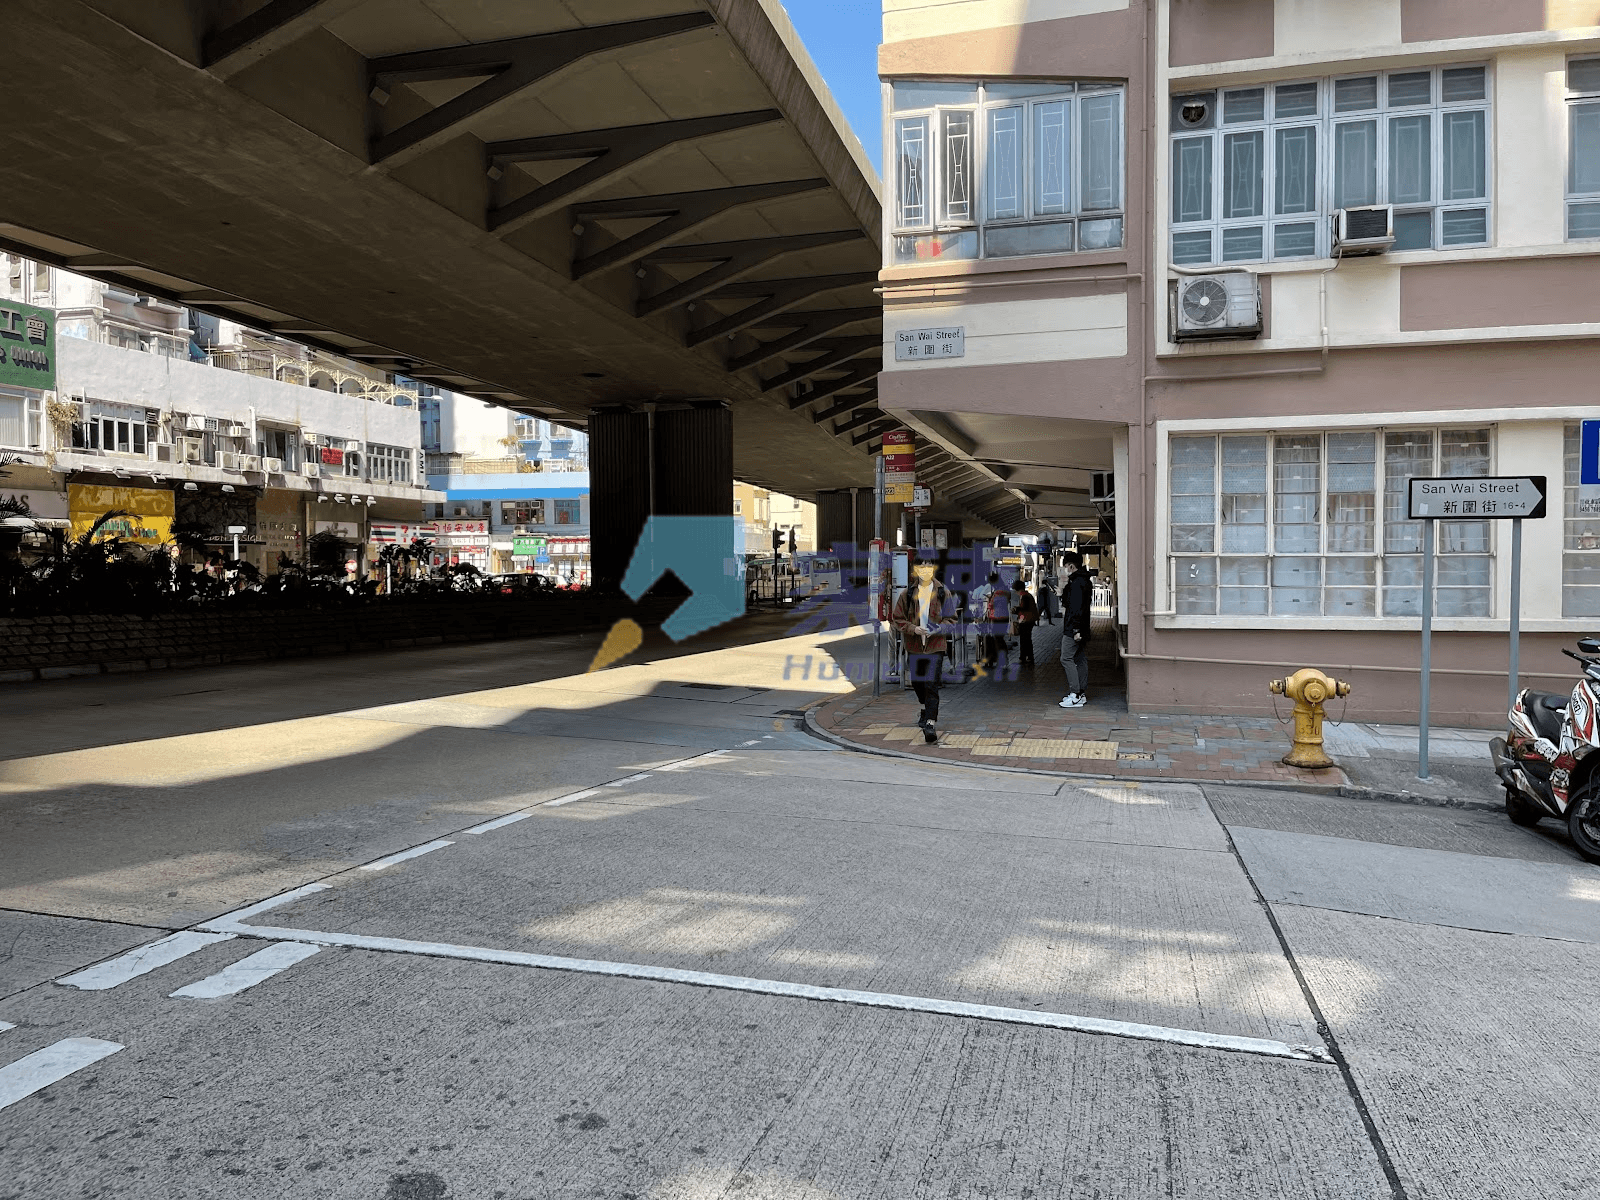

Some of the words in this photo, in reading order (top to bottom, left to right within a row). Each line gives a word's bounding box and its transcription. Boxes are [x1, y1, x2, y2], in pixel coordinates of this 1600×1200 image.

[899, 333, 914, 342] San
[918, 331, 933, 341] Wai
[936, 328, 960, 340] Street
[907, 343, 953, 356] 新圍街
[1421, 483, 1447, 495] San
[1450, 483, 1475, 494] Wai
[1479, 482, 1520, 493] Street
[1443, 500, 1497, 514] 新圍街
[1502, 501, 1526, 510] 16-4
